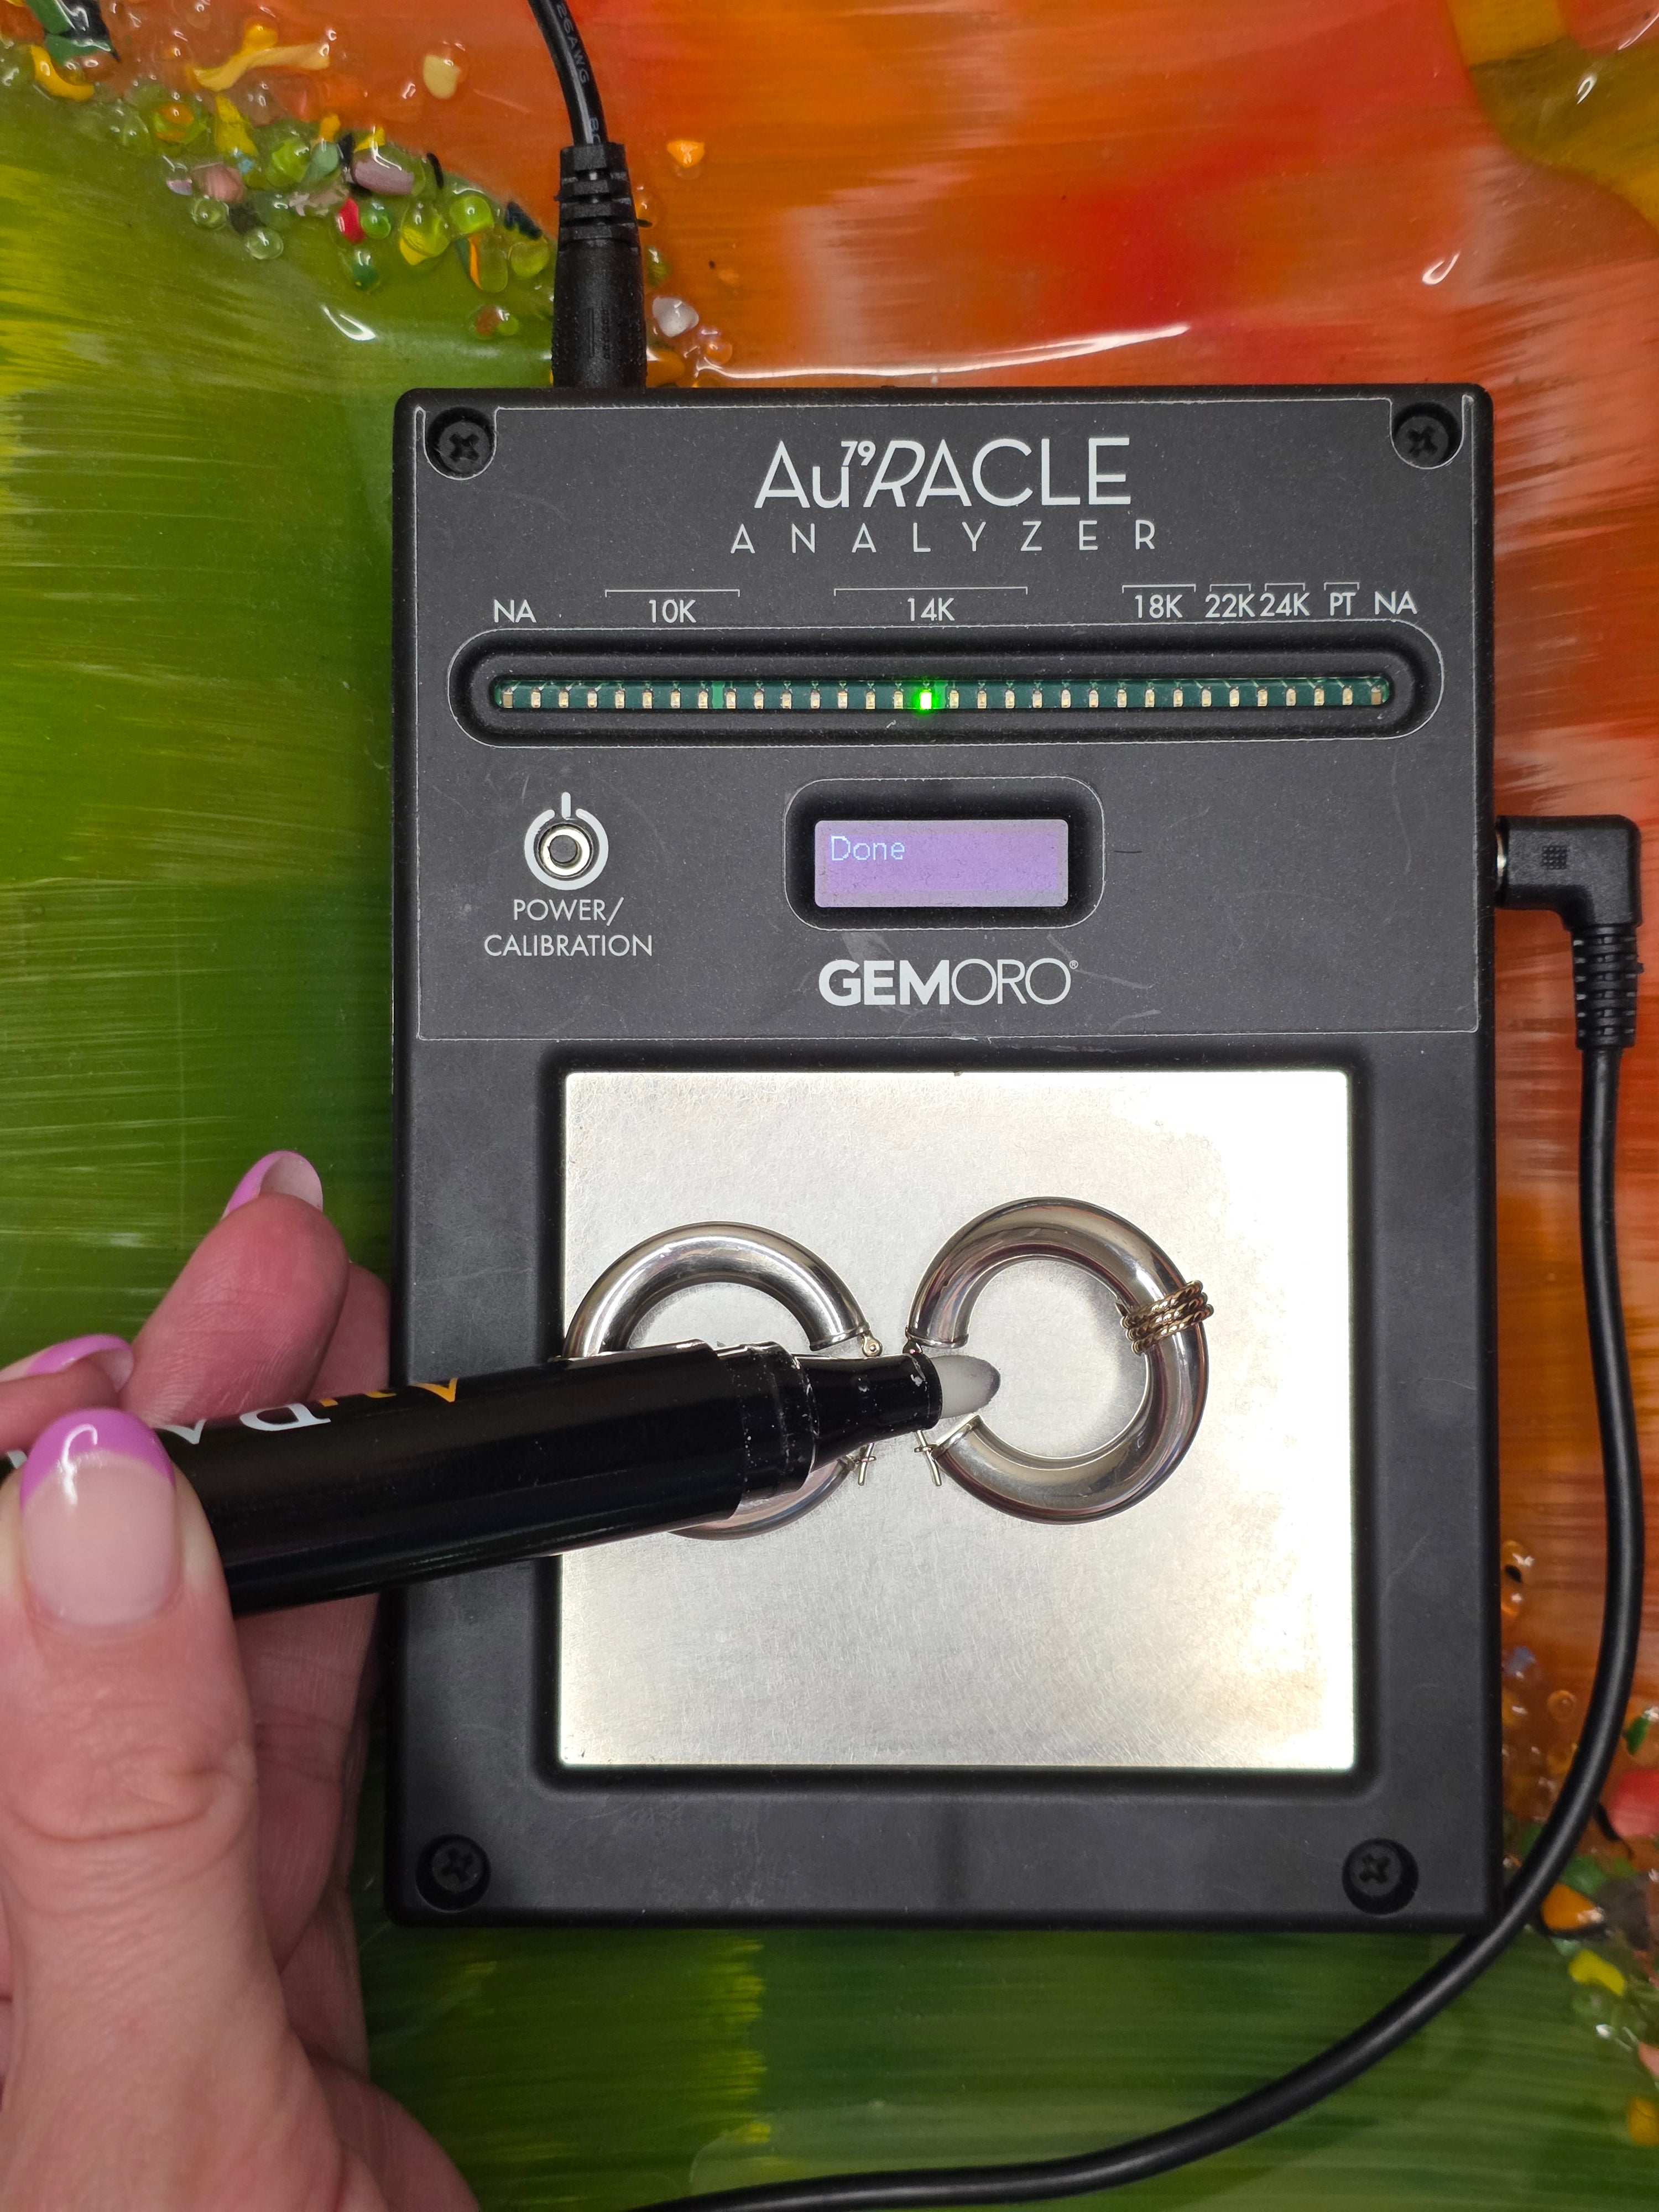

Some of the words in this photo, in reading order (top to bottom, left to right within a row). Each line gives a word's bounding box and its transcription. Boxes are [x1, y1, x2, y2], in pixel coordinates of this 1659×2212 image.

[556, 3, 589, 84] 26AWG
[729, 519, 1156, 554] ANALYZER
[493, 599, 538, 623] NA
[648, 598, 697, 623] 10K
[907, 597, 956, 622] 14K
[1134, 593, 1183, 619] 18K
[1204, 593, 1256, 618] 22K
[1259, 592, 1311, 617] 24K
[1329, 592, 1357, 616] PT
[1374, 591, 1418, 615] NA
[831, 836, 905, 861] Done
[513, 896, 624, 926] POWER/
[483, 934, 653, 957] CALIBRATION
